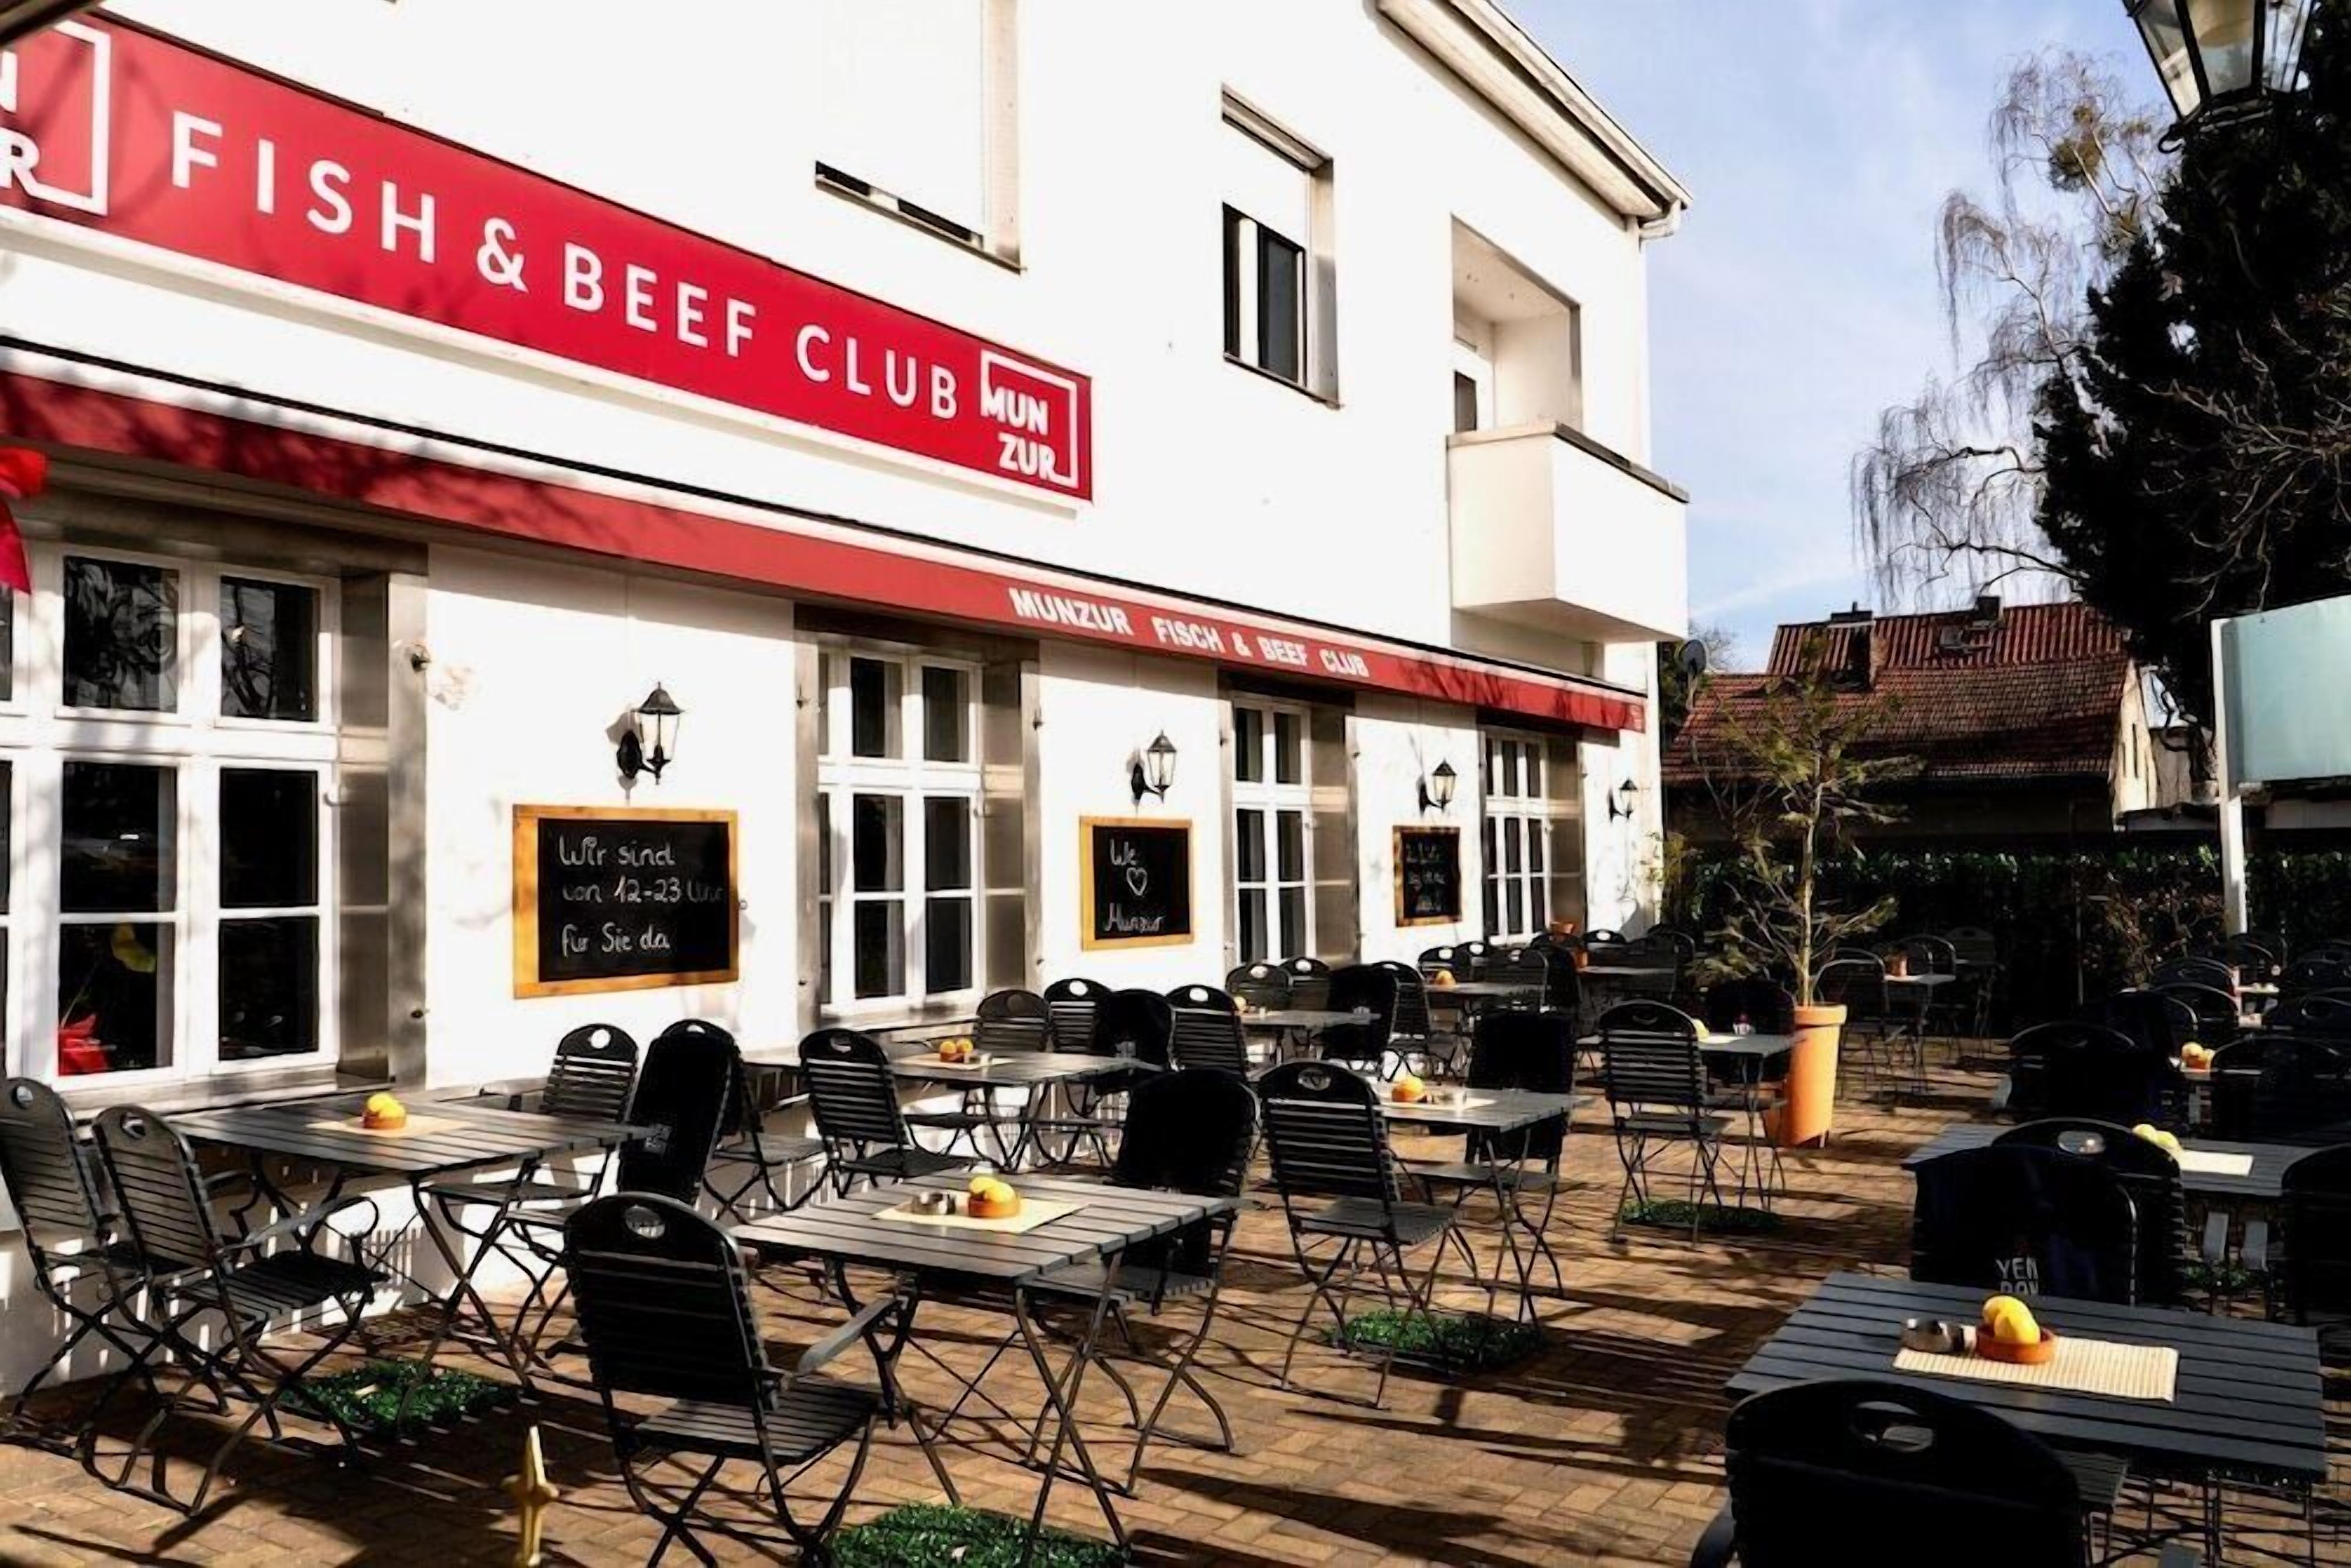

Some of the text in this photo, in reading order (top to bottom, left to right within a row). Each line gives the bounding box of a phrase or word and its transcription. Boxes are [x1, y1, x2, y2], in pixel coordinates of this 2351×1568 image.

[172, 110, 958, 418] FISH & BEEF CLUB
[980, 381, 1049, 436] MUN
[997, 431, 1058, 482] ZUR
[1009, 588, 1370, 678] MUNZUR FISCH & BEEF CLUB
[560, 835, 676, 867] Wir sind
[614, 875, 682, 903] 12-23
[601, 922, 633, 953] Sie
[639, 924, 671, 950] da
